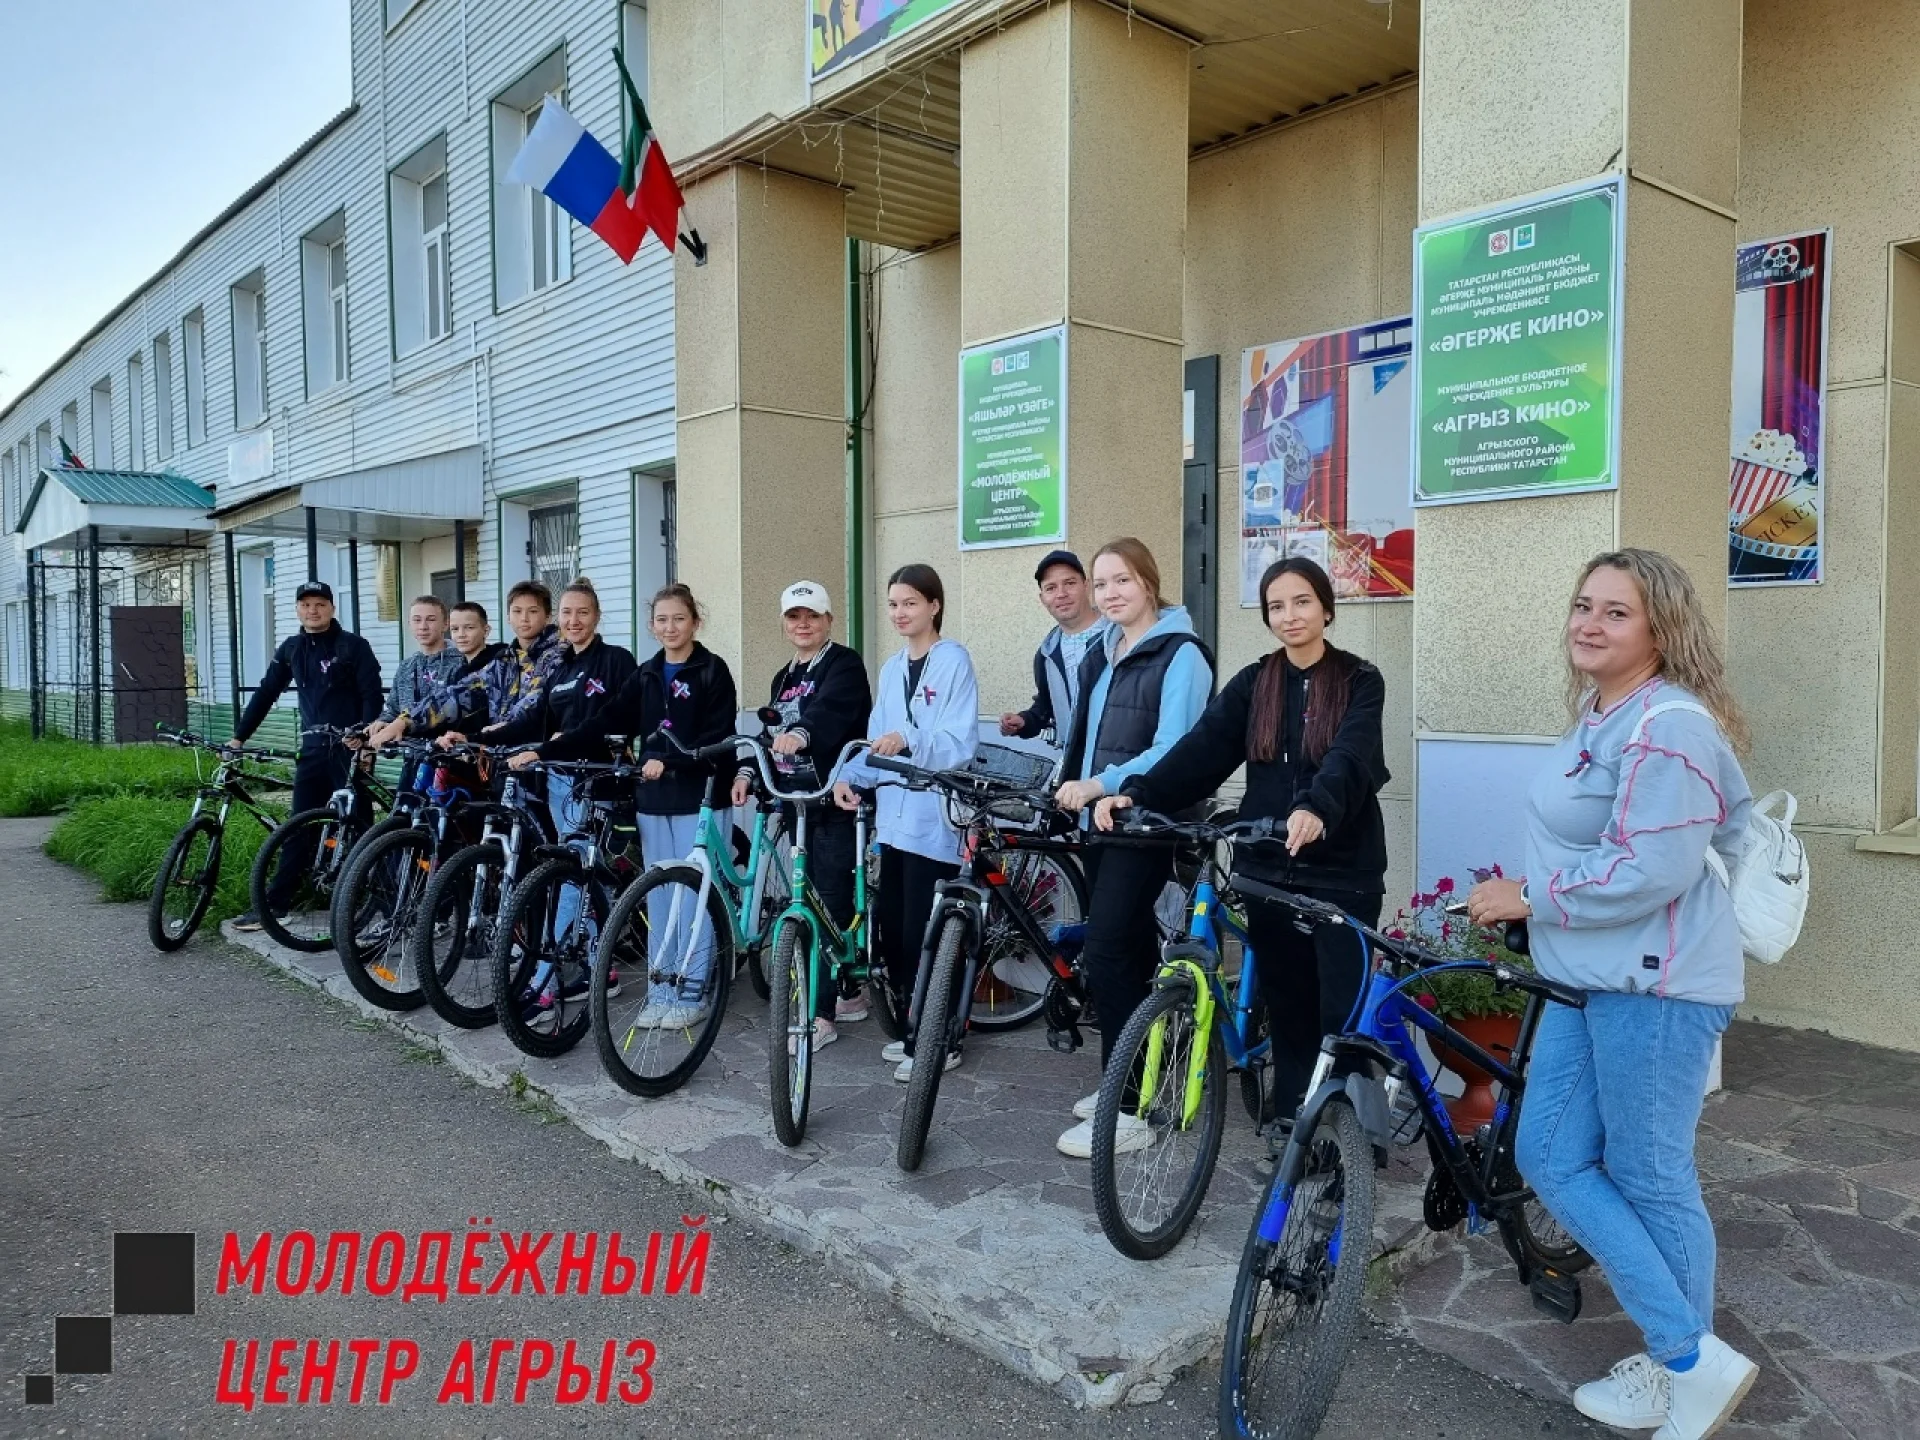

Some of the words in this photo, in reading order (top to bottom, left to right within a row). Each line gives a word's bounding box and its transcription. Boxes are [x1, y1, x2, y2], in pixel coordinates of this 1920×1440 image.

[1449, 272, 1499, 290] ТАТАРСТАН
[1501, 253, 1580, 279] РЕСПУБЛИКАСЫ
[1477, 274, 1543, 295] МУНИЦИПАЛЬ
[1547, 264, 1590, 280] РАЙОНЫ
[1431, 296, 1494, 316] МУНИЦИПАЛЬ
[1554, 273, 1600, 291] БЮДЖЕТ
[1528, 308, 1605, 337] КИНО»
[1437, 375, 1520, 396] МУНИЦИПАЛЬНОЕ
[1522, 363, 1587, 382] БЮДЖЕТНОЕ
[1452, 387, 1515, 404] УЧРЕЖДЕНИЕ
[1516, 378, 1570, 394] КУЛЬТУРЫ
[1432, 408, 1510, 433] «АГРЫЗ
[1516, 398, 1591, 424] КИНО»
[1444, 449, 1533, 466] МУНИЦИПАЛЬНОГО
[1535, 443, 1576, 456] РАЙОНА
[1477, 436, 1539, 451] АГРЫЗСКОГО
[971, 464, 1051, 489] «МОЛОДЁЖНЫЙ
[1451, 461, 1510, 477] РЕСПУБЛИКИ
[1513, 455, 1567, 470] ТАТАРСТАН
[991, 487, 1028, 504] ЦЕНТР»
[1755, 497, 1818, 542] ICKET
